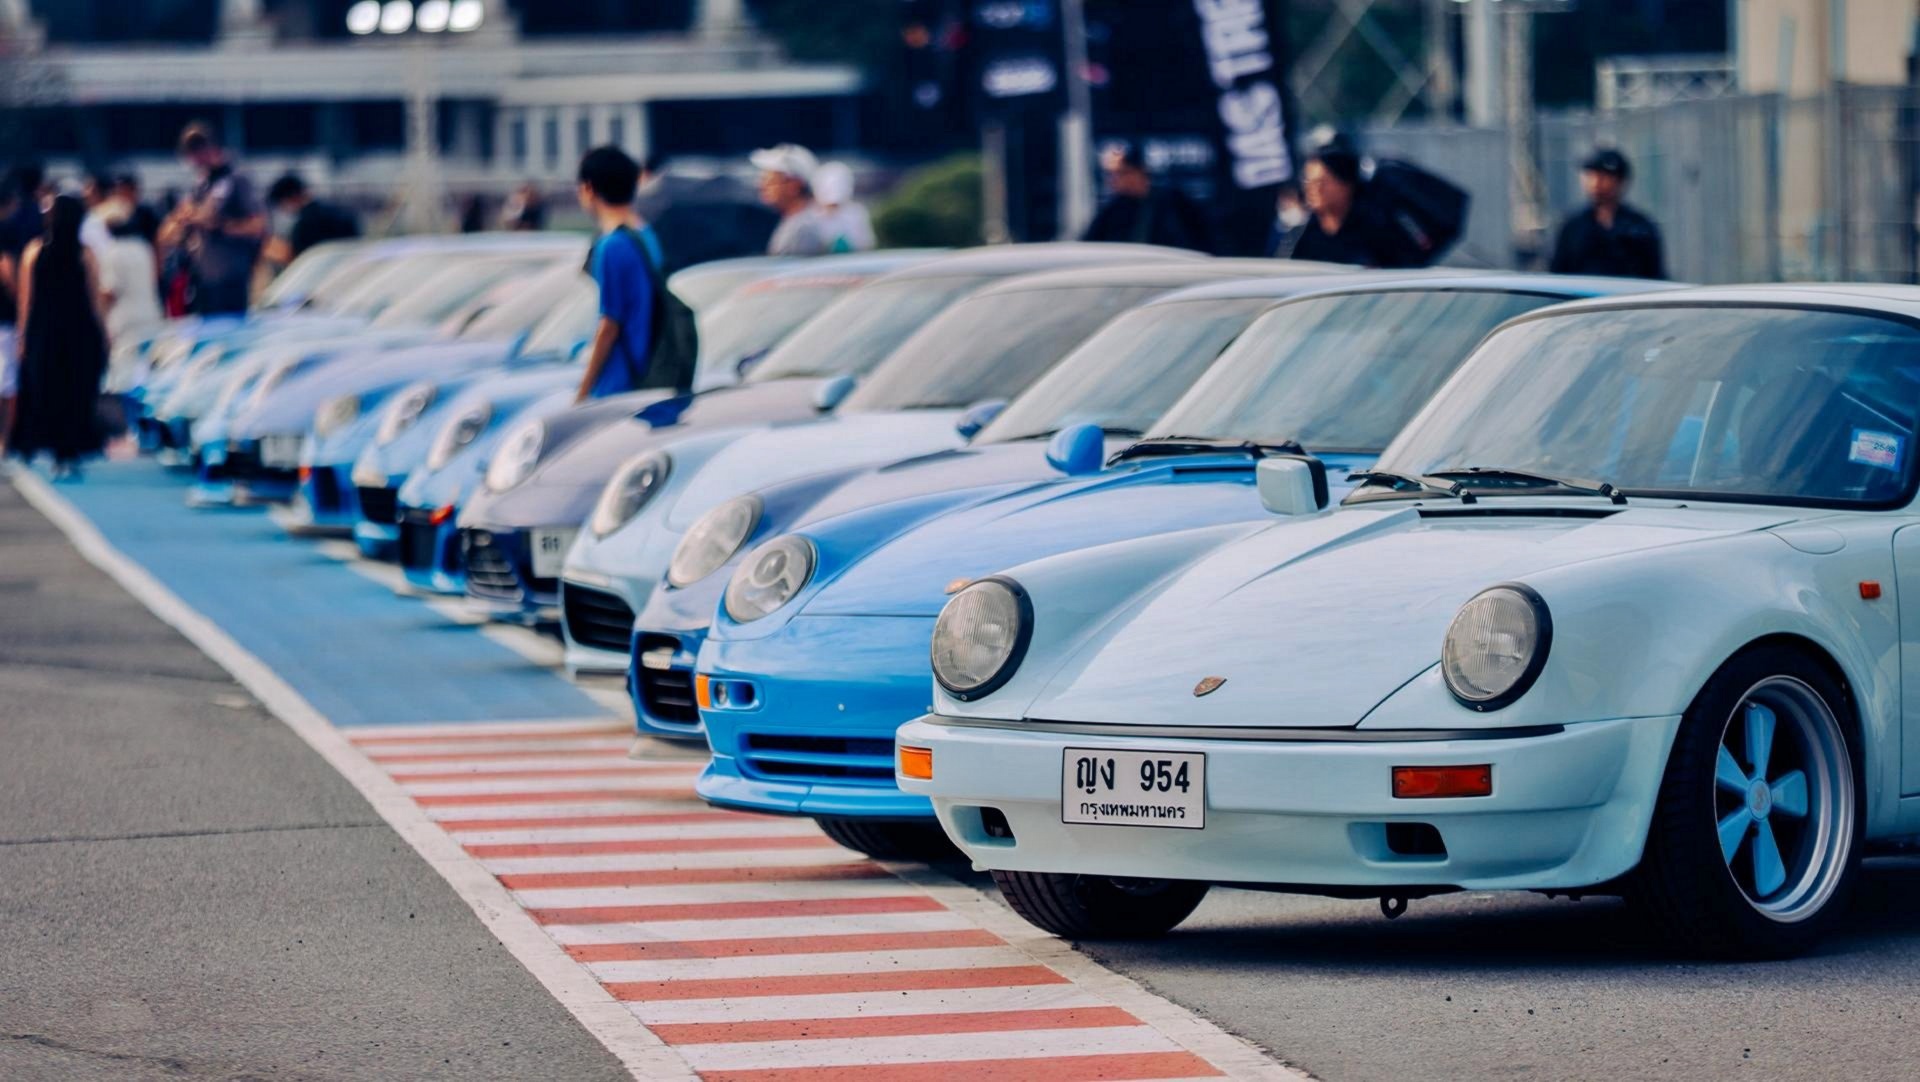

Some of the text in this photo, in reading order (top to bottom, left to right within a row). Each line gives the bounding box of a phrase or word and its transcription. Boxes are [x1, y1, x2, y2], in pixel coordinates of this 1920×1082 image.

[1217, 81, 1292, 189] DAS
[1077, 757, 1190, 794] ญง 954
[1080, 802, 1186, 820] กรุงเทพมหานคร
